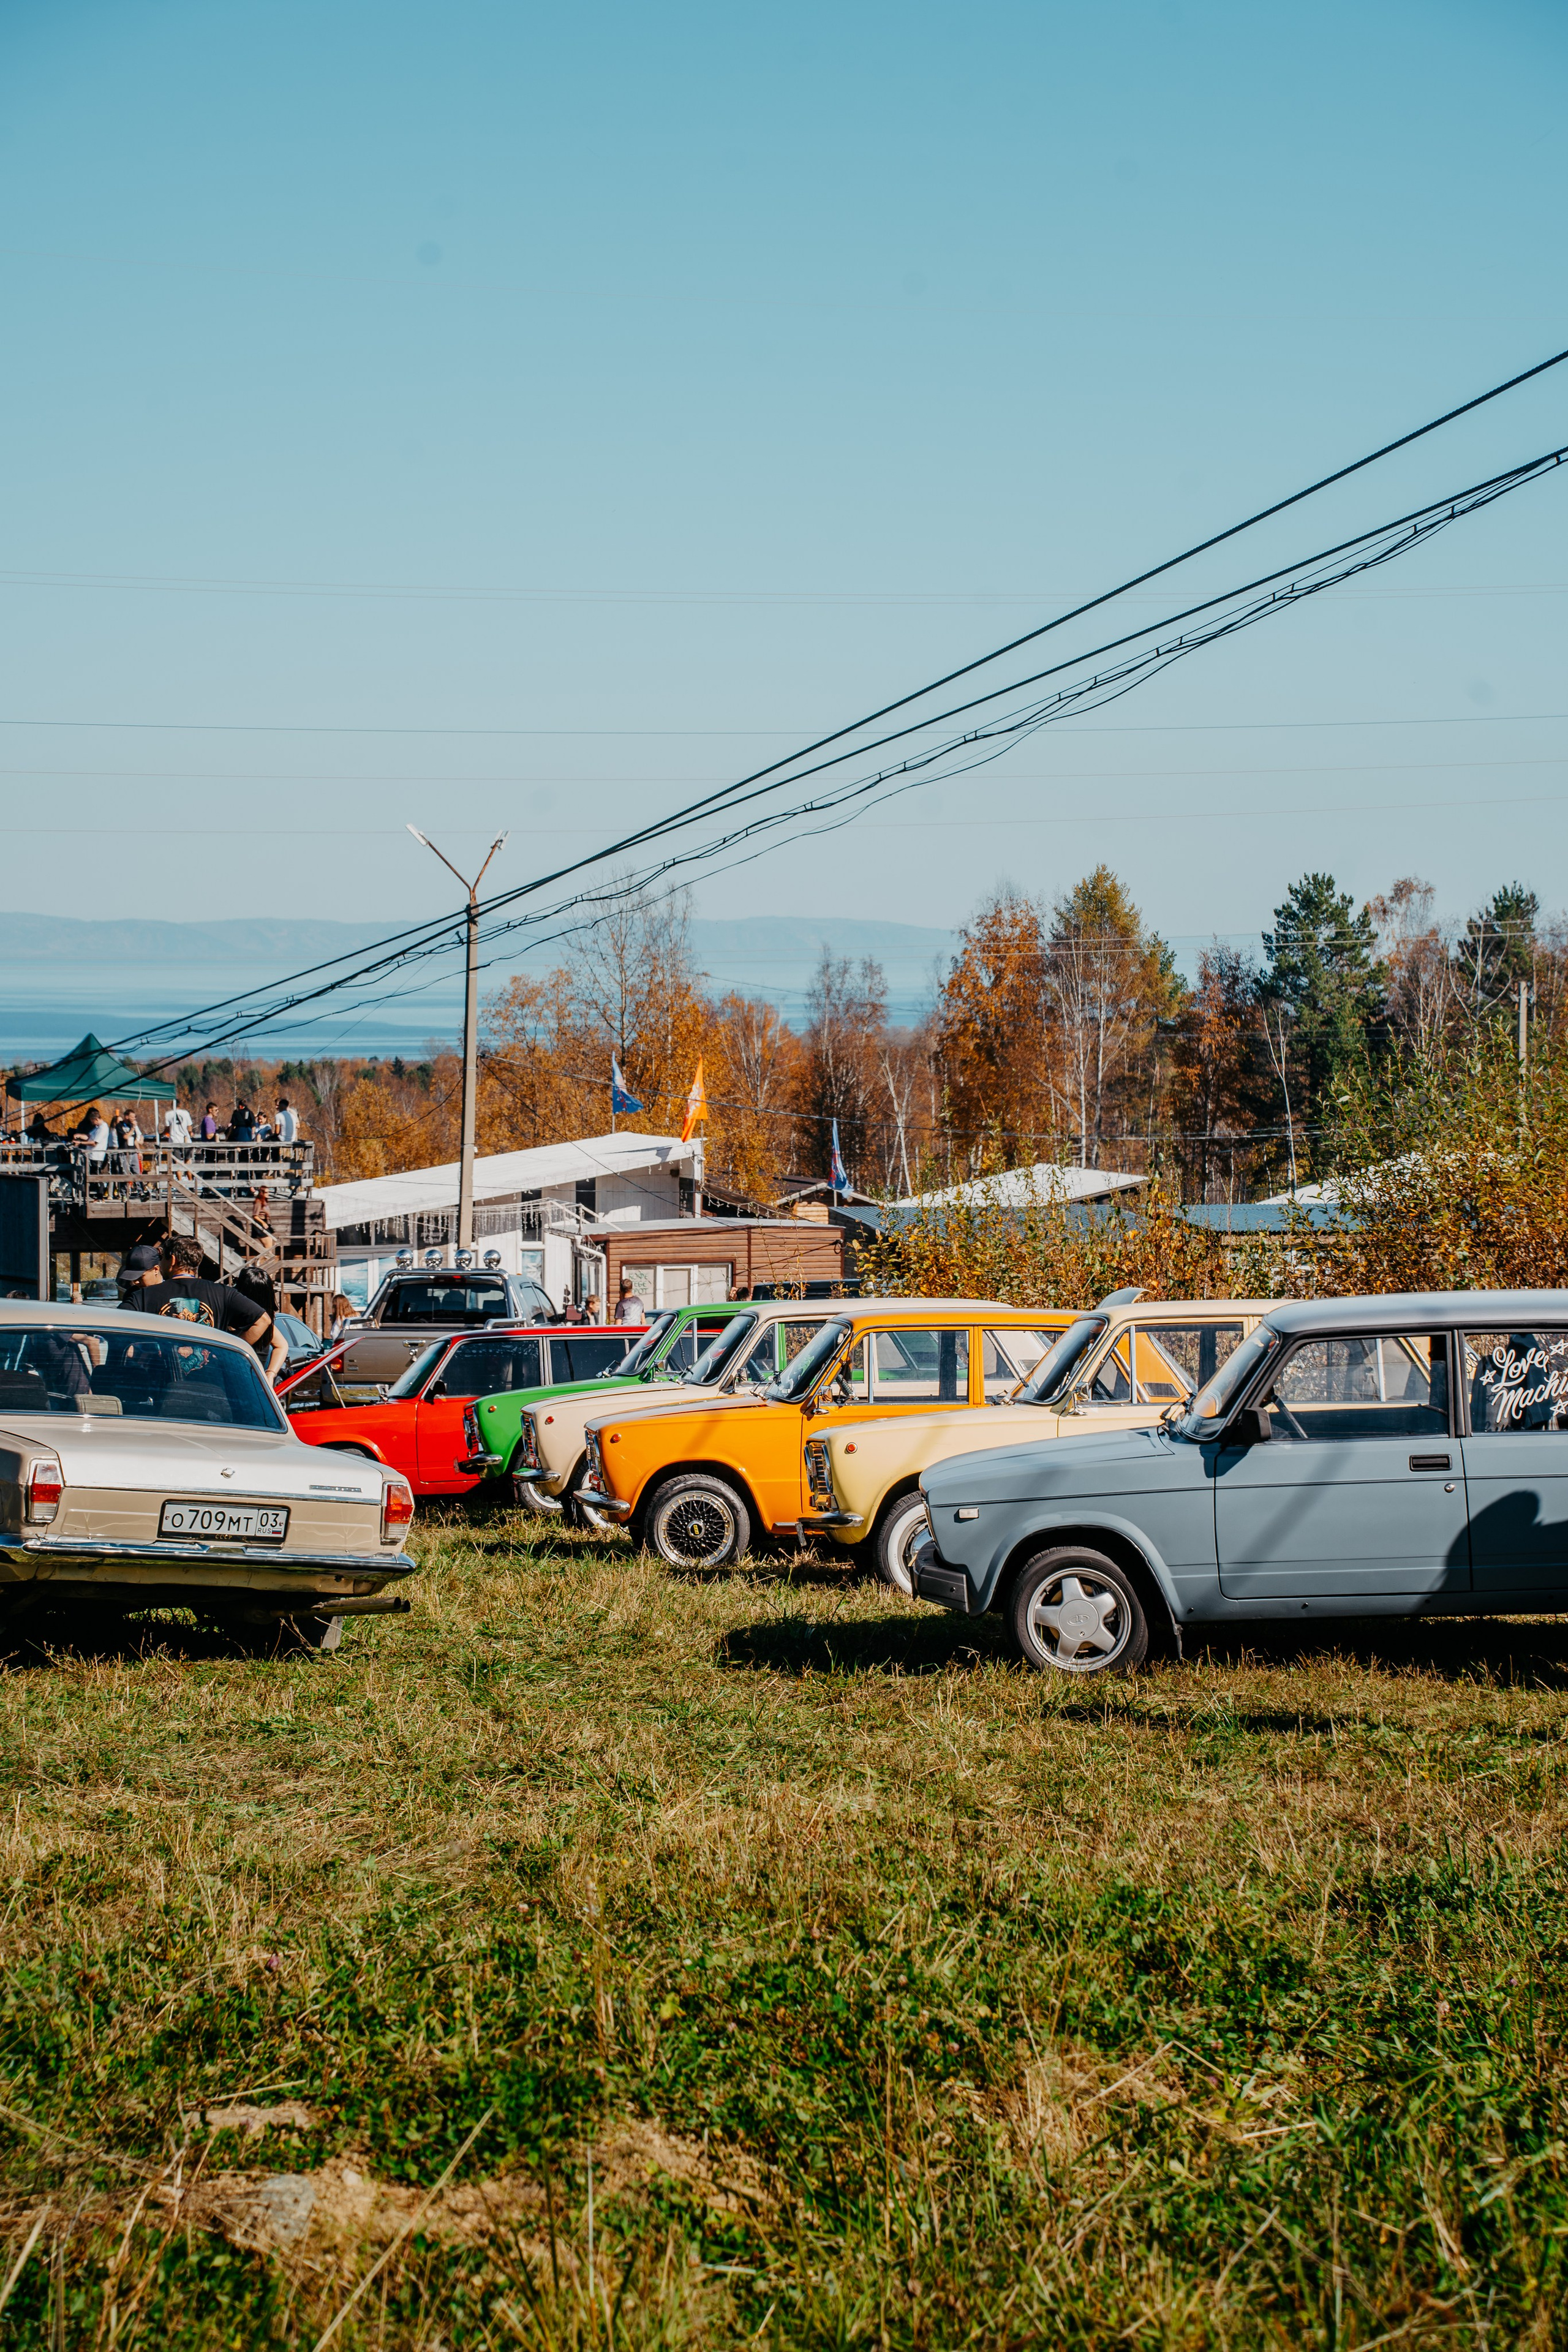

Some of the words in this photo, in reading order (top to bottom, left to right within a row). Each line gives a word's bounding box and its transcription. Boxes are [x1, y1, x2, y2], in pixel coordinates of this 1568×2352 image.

[1491, 1346, 1549, 1392] Love
[1491, 1370, 1568, 1423] Machi
[260, 1512, 279, 1528] 03
